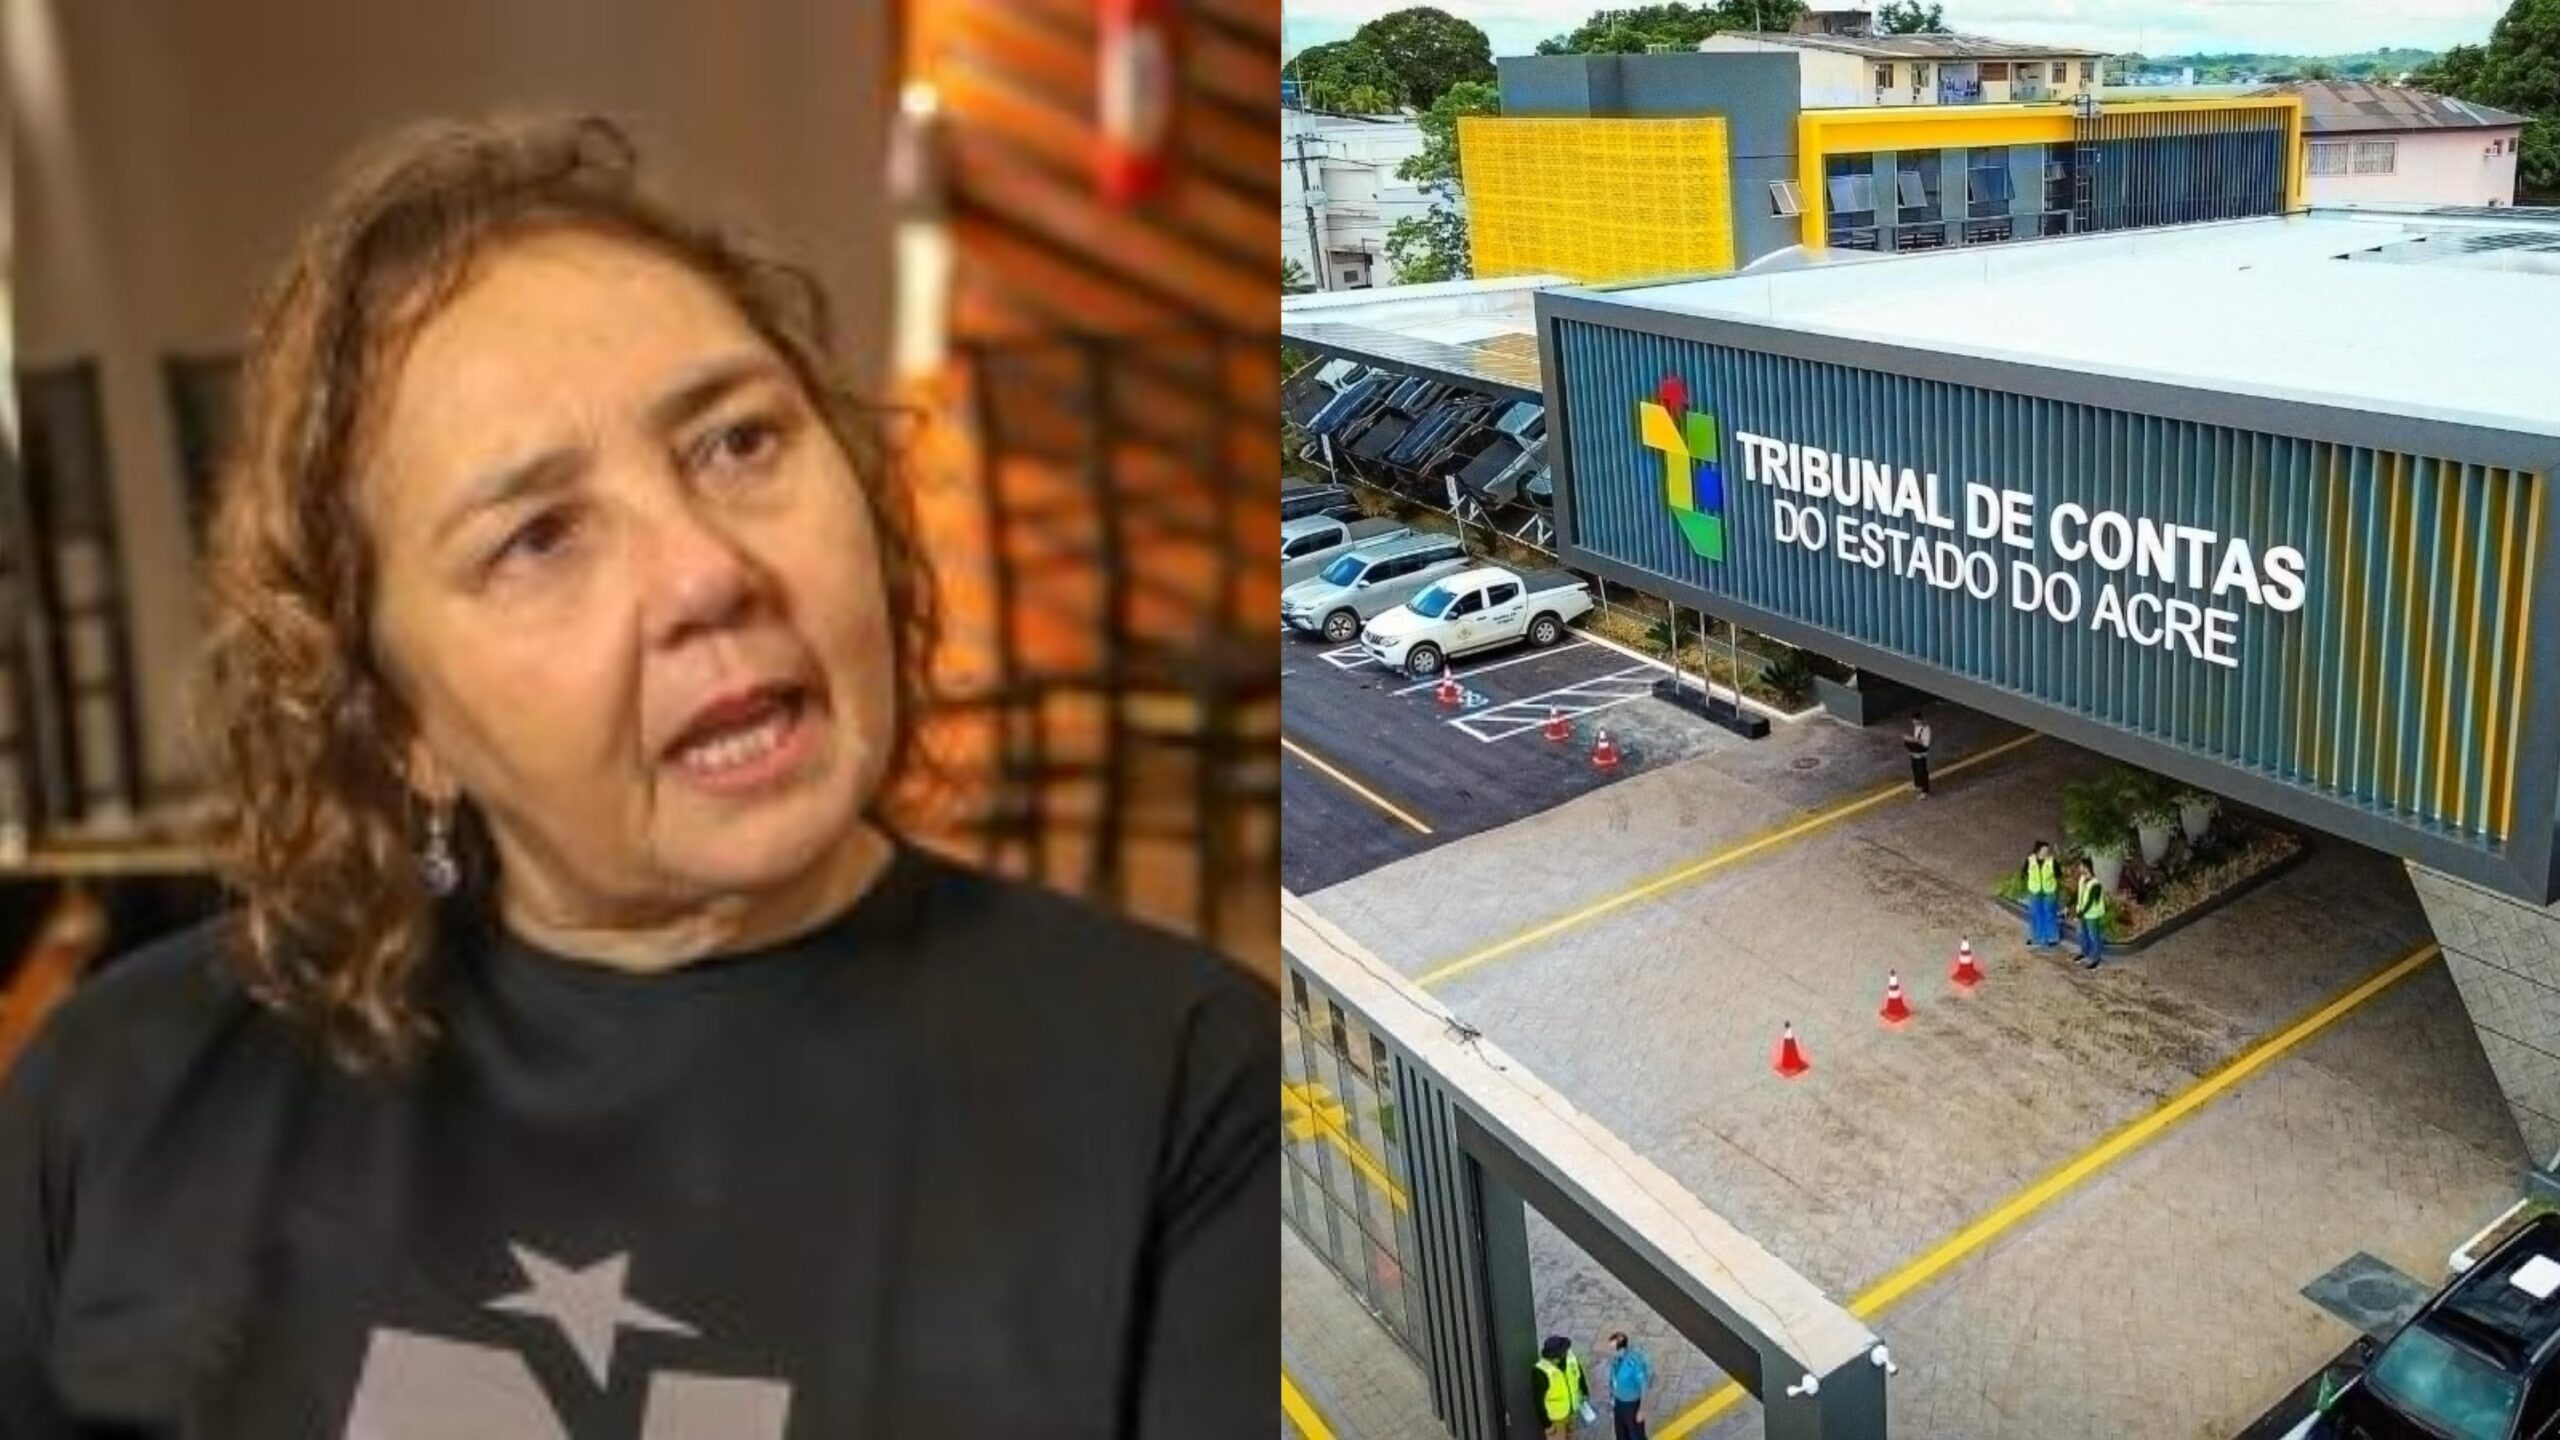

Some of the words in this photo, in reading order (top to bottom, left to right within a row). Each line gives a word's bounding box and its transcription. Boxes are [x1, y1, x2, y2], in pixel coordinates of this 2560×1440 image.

[1736, 431, 1954, 530] TRIBUNAL
[1966, 481, 2034, 550] DE
[2050, 502, 2306, 611] CONTAS
[1774, 499, 1827, 551] DO
[1836, 515, 1998, 600] ESTADO
[2012, 560, 2082, 623] DO
[2090, 583, 2239, 668] ACRE
